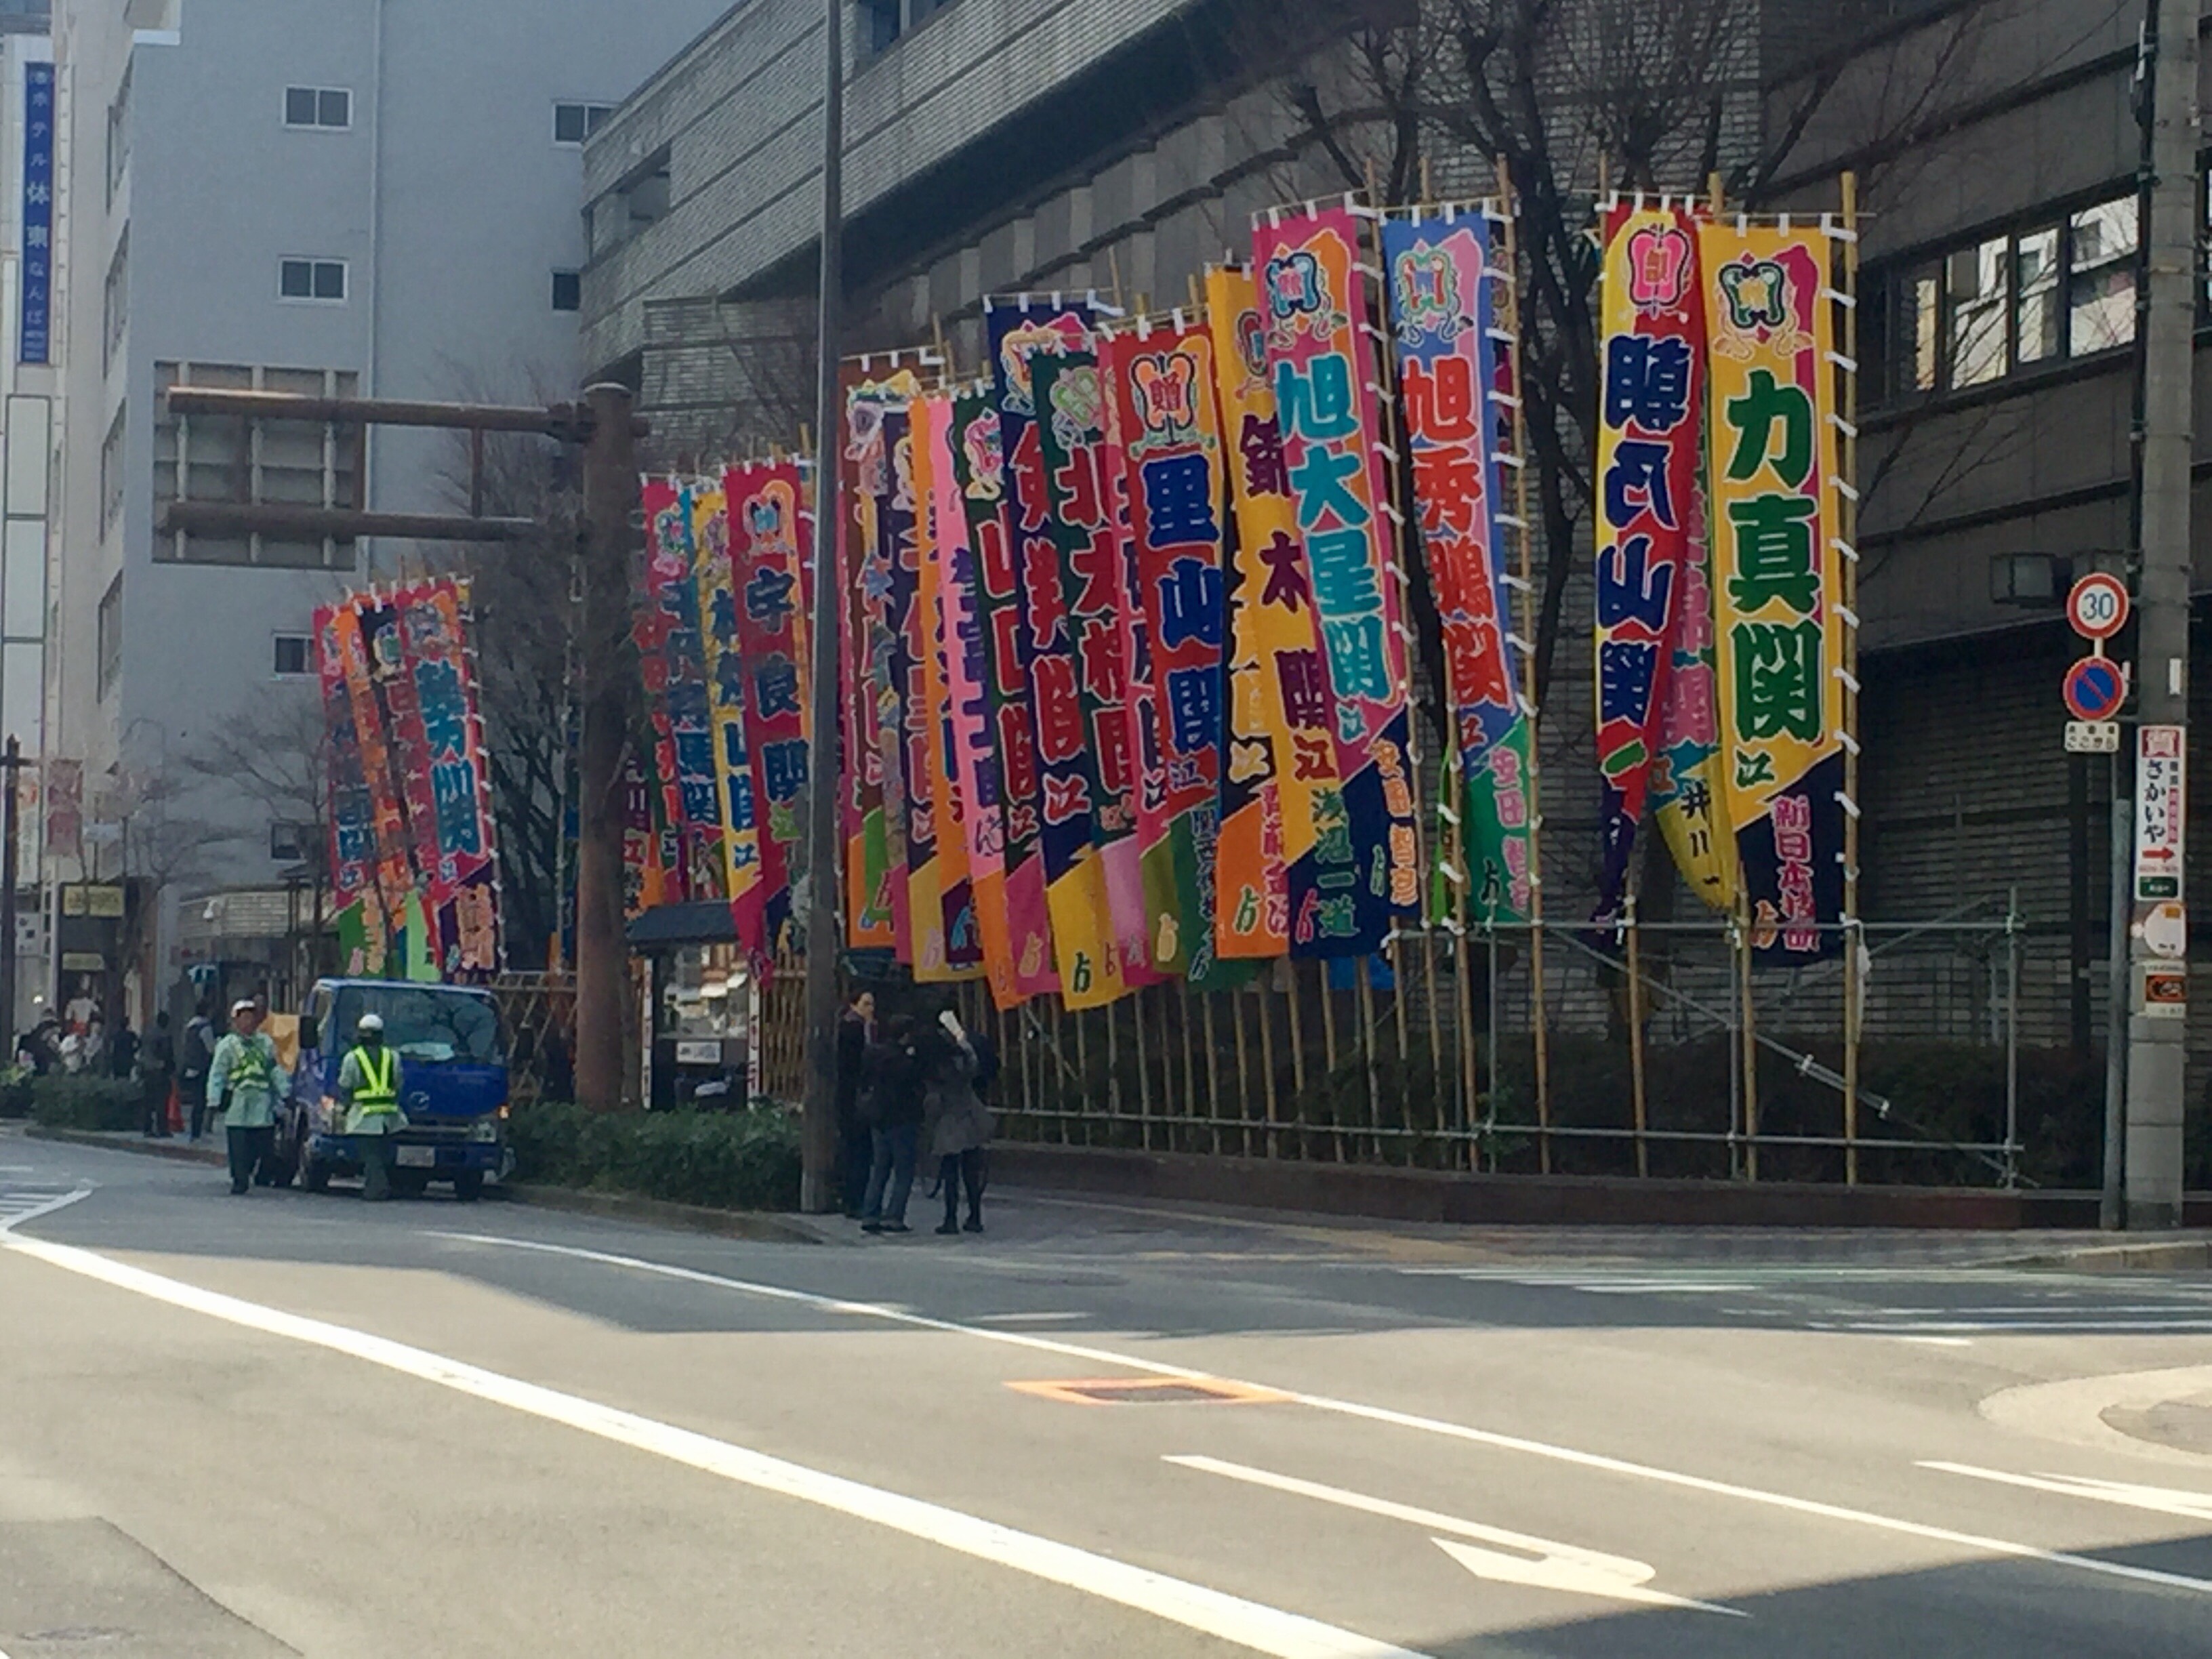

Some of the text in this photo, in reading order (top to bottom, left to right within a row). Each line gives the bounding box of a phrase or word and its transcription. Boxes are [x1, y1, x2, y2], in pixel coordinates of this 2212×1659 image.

[1141, 453, 1222, 756] 里山関
[1274, 352, 1393, 702] 旭大星関
[1401, 356, 1511, 708] 旭秀鵬関
[1723, 369, 1824, 743] 力真関
[2083, 592, 2114, 619] 30
[2144, 759, 2167, 843] さかいや
